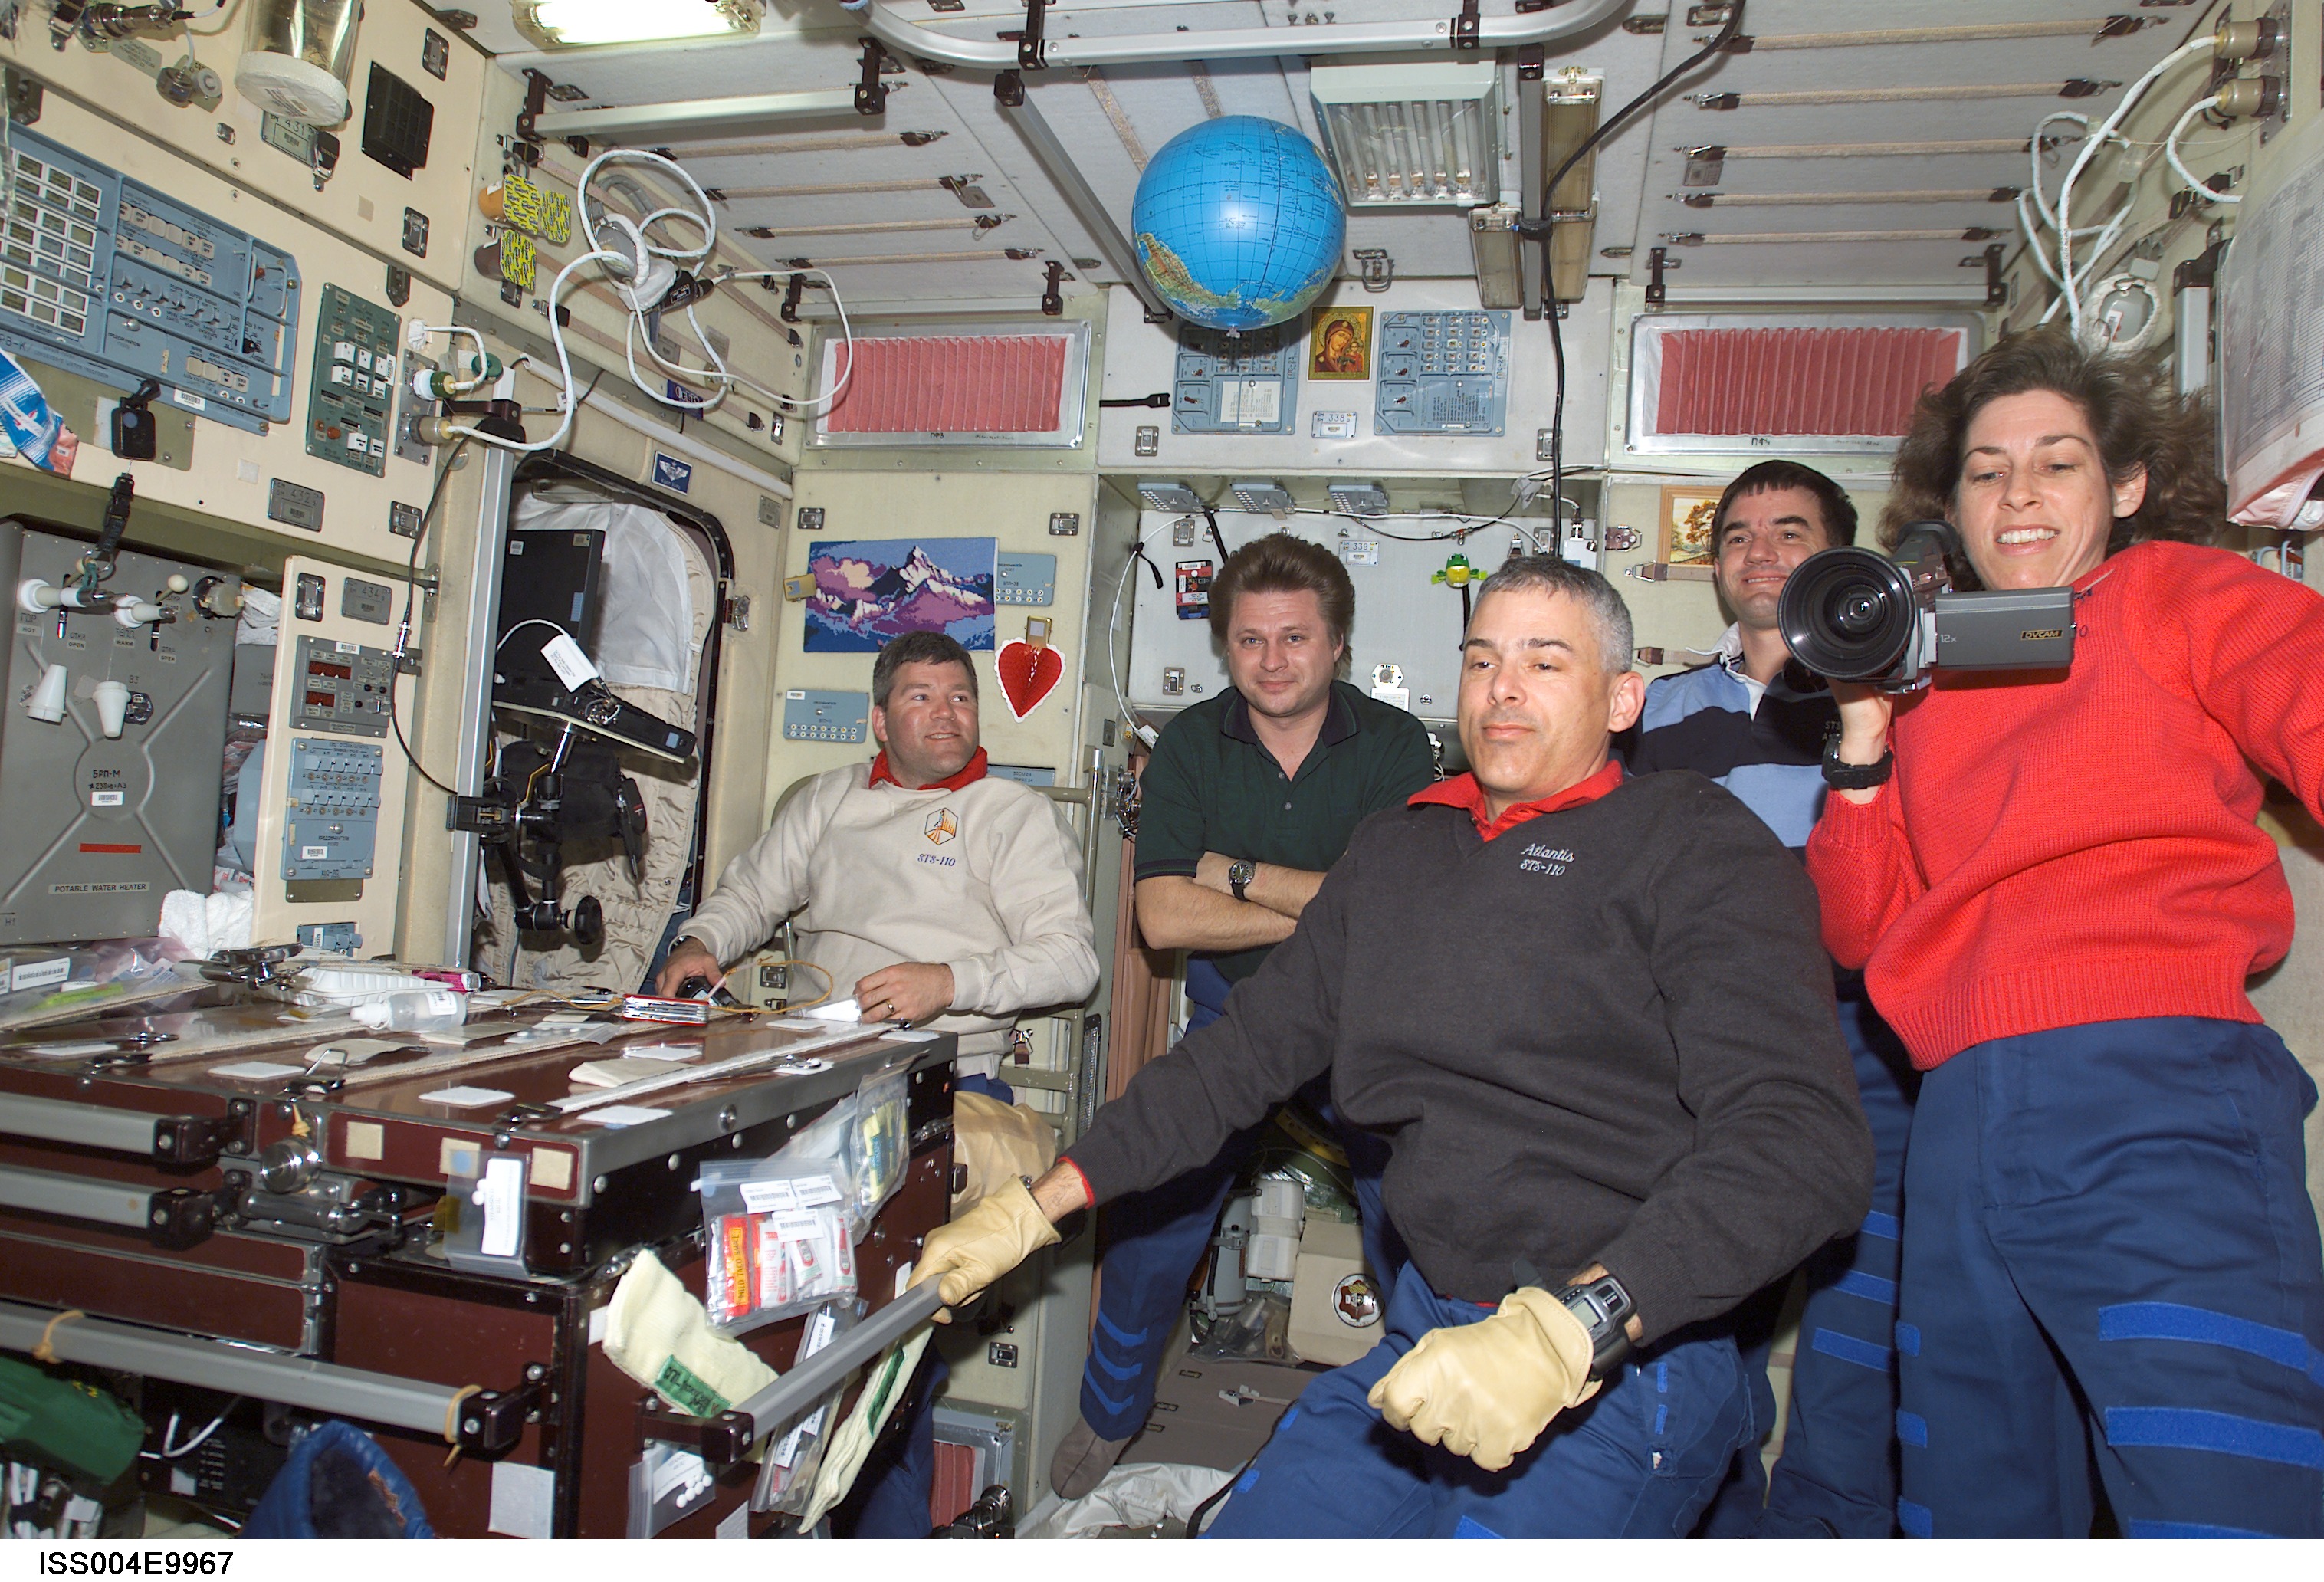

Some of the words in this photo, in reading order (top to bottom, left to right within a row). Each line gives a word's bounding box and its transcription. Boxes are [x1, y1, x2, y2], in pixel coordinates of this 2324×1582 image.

[286, 119, 304, 136] 431
[1328, 414, 1345, 422] 338
[290, 488, 311, 504] 432
[362, 586, 379, 598] 434
[2024, 630, 2060, 638] DVCAM
[93, 769, 121, 780] БРП-М
[917, 853, 956, 867] STS-110
[1521, 842, 1575, 862] Atlantis
[1520, 858, 1566, 876] STS-110
[54, 885, 88, 893] POTABLE
[730, 1233, 740, 1255] SAUCE
[734, 1259, 744, 1278] TACO
[736, 1278, 745, 1299] MILD
